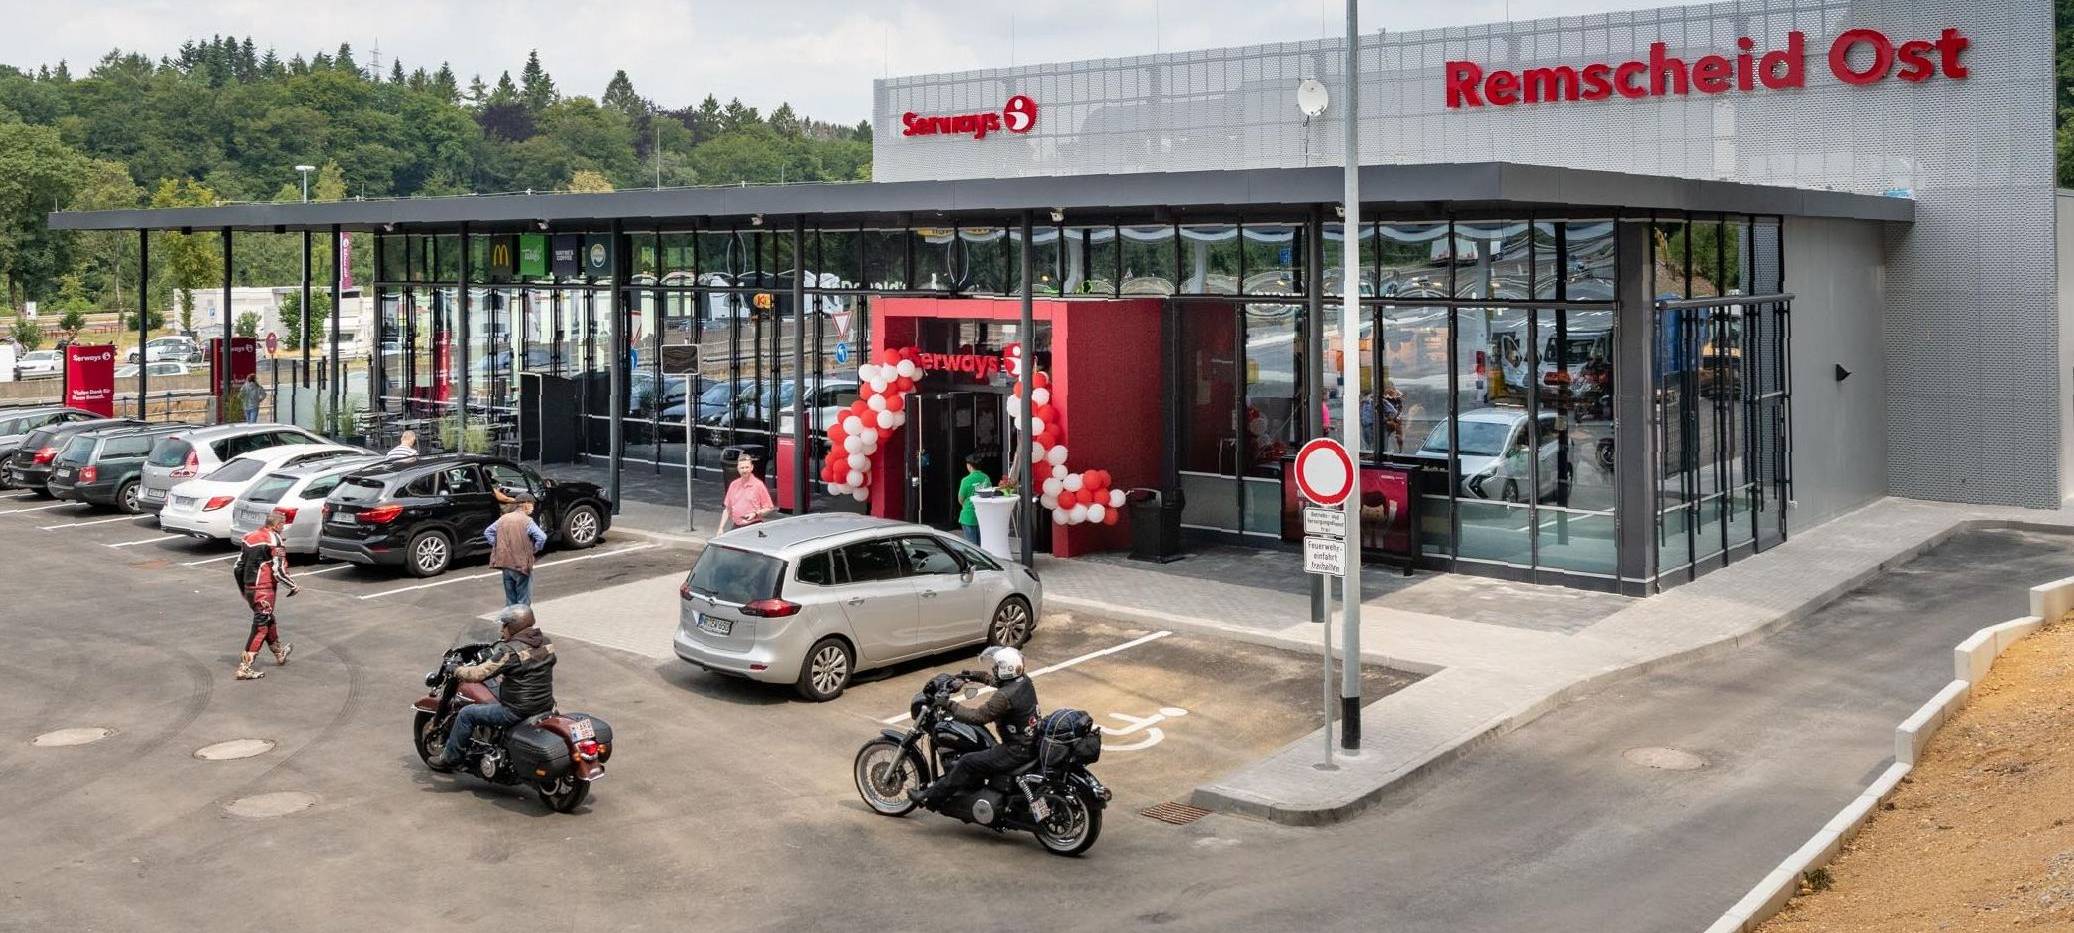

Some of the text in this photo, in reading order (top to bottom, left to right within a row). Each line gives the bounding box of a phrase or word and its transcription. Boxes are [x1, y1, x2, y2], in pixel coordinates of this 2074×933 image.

[1445, 27, 1969, 108] Remscheid Ost
[902, 111, 1001, 140] Serways
[920, 352, 999, 379] erways
